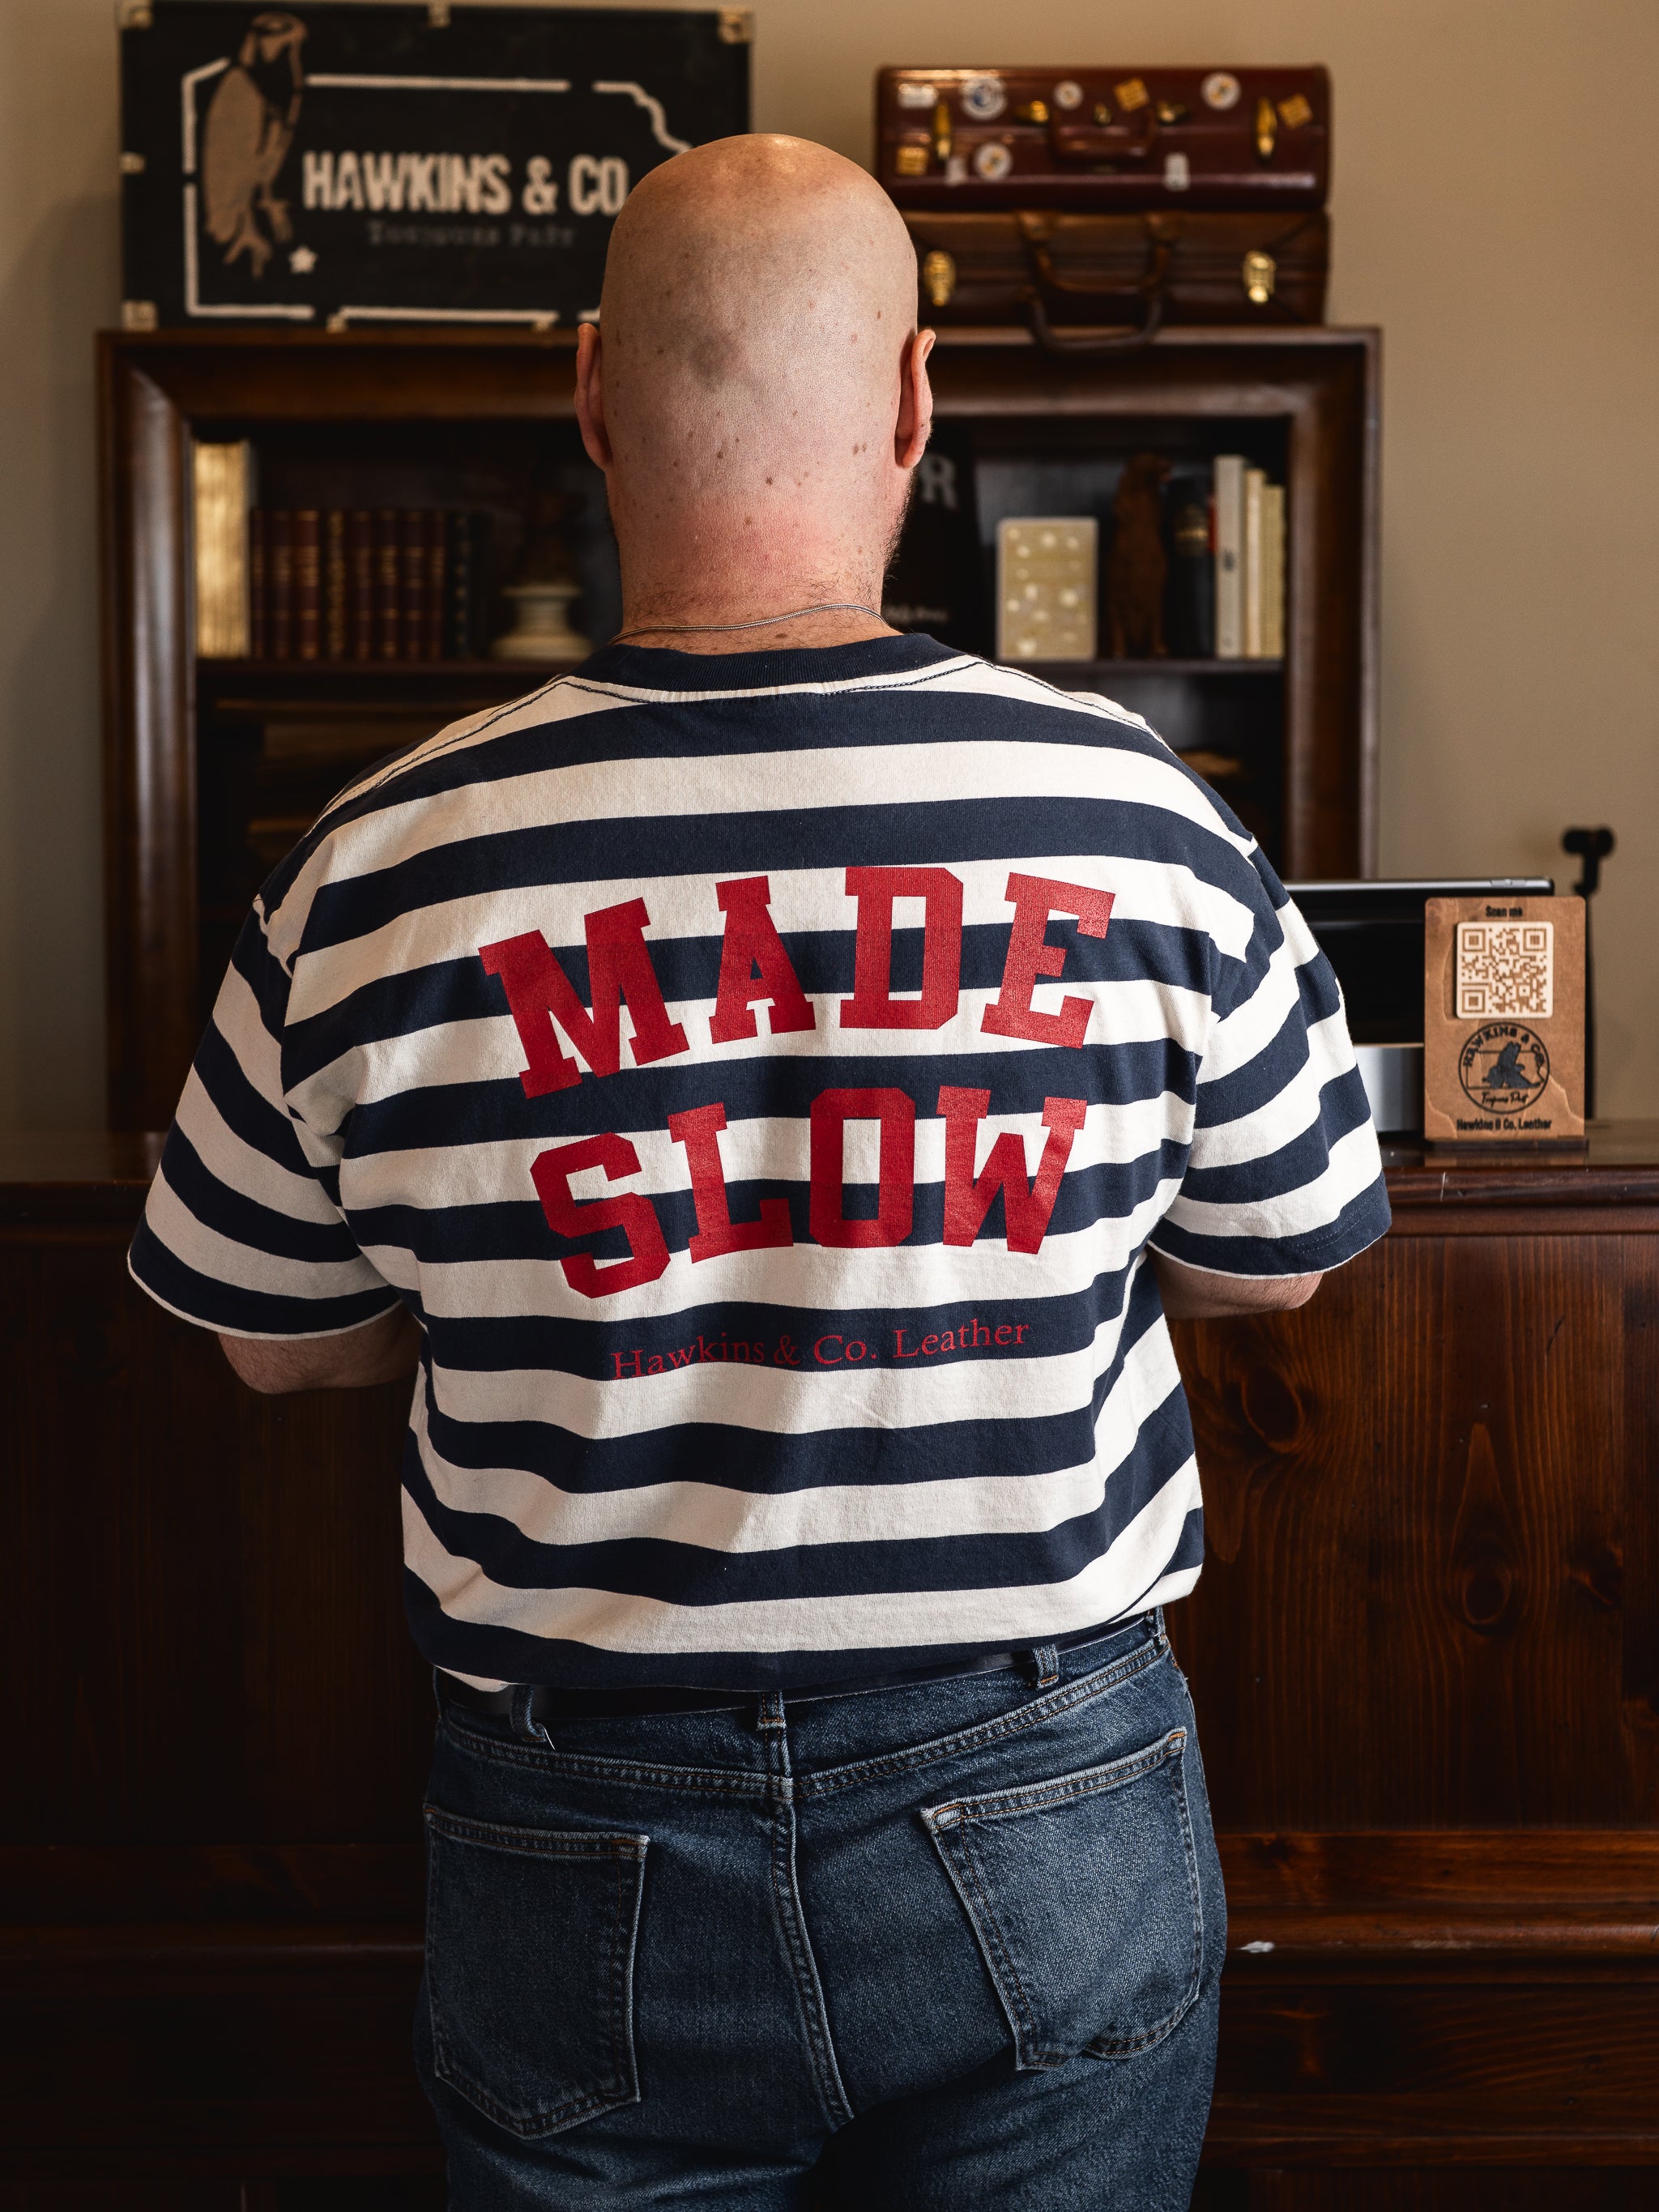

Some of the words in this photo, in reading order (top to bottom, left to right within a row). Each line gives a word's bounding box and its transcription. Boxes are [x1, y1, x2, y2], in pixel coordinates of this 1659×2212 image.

[302, 150, 512, 215] HAWKINS
[521, 155, 560, 215] &
[478, 866, 1115, 1099] MADE
[530, 1085, 1087, 1299] SLOW
[611, 1332, 765, 1380] Hawkins
[774, 1334, 801, 1366] &
[813, 1334, 878, 1365] Co.
[893, 1318, 1030, 1358] Leather
